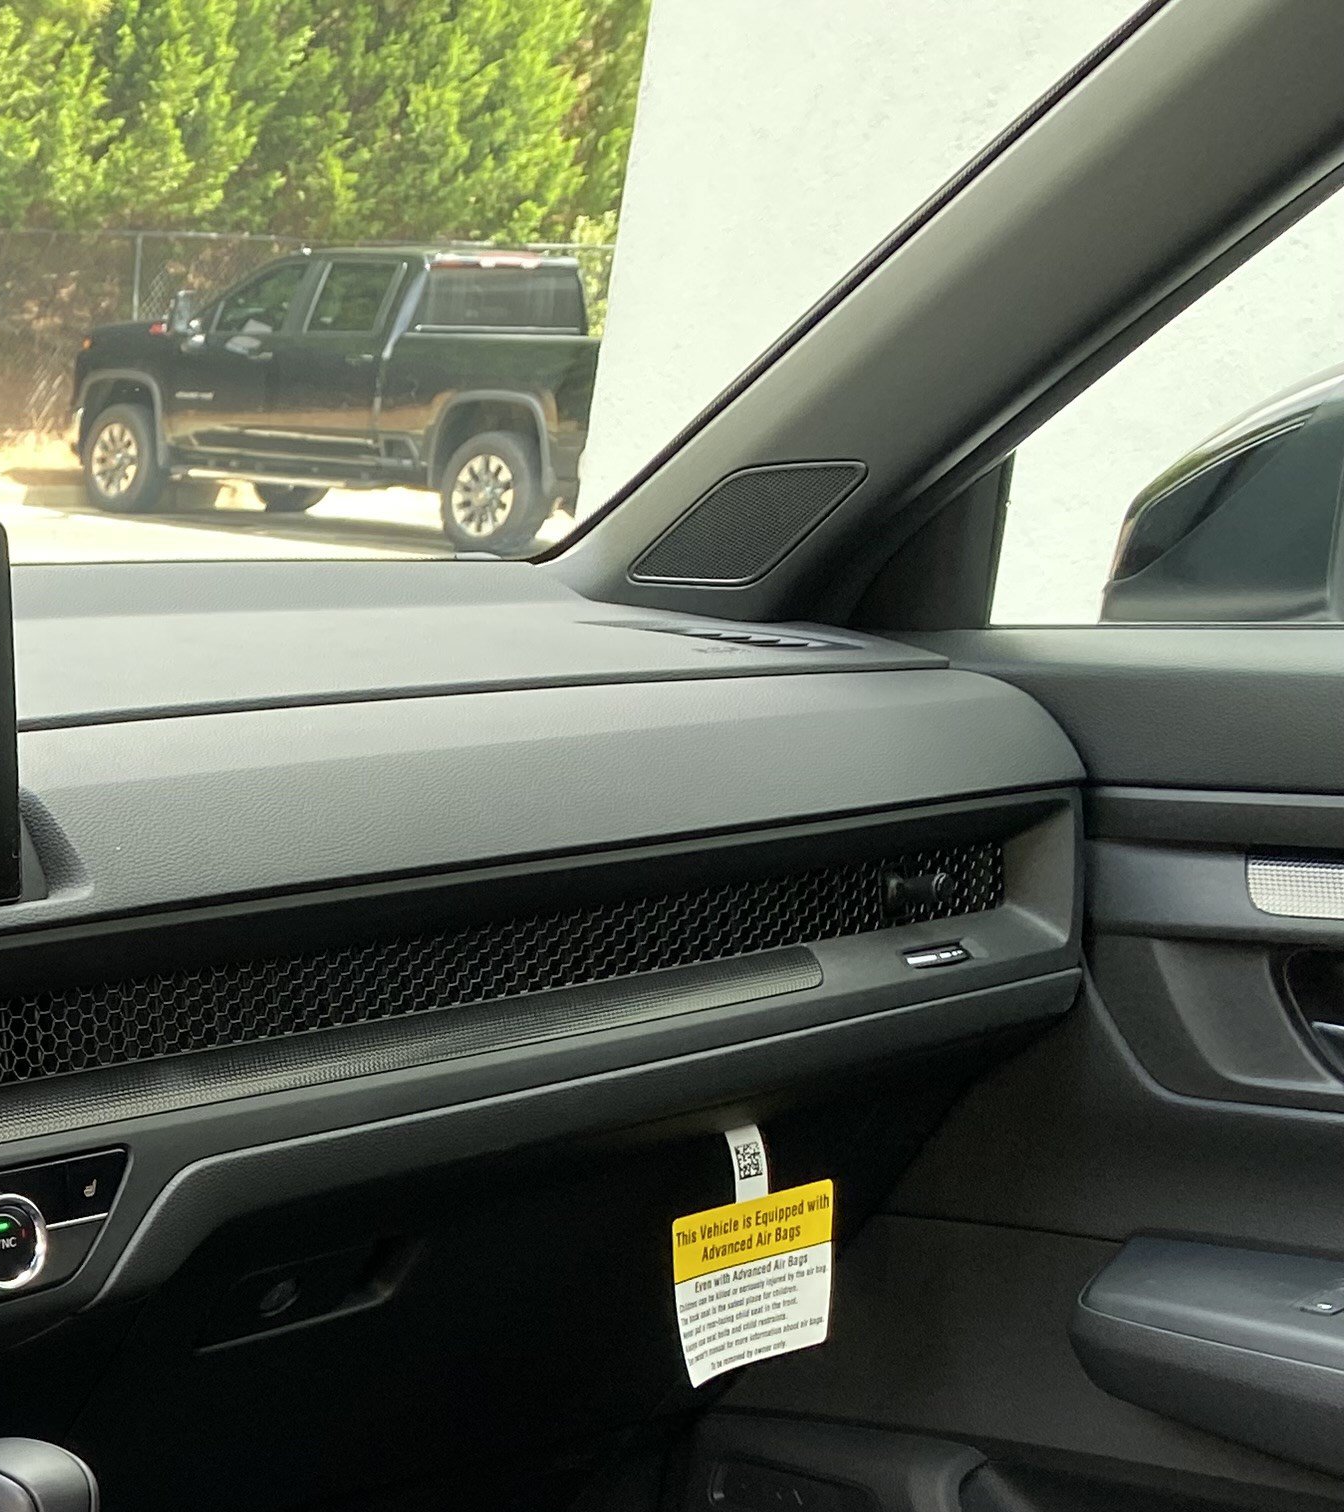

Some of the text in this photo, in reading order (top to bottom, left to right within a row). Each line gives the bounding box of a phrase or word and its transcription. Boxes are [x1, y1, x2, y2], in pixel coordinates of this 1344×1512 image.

[676, 1193, 830, 1247] This Vehicle is Equipped with
[702, 1224, 801, 1262] Advanced Air Bags
[714, 1273, 731, 1287] with
[733, 1261, 772, 1282] Advanced
[774, 1257, 786, 1271] Air
[788, 1253, 809, 1269] Bags
